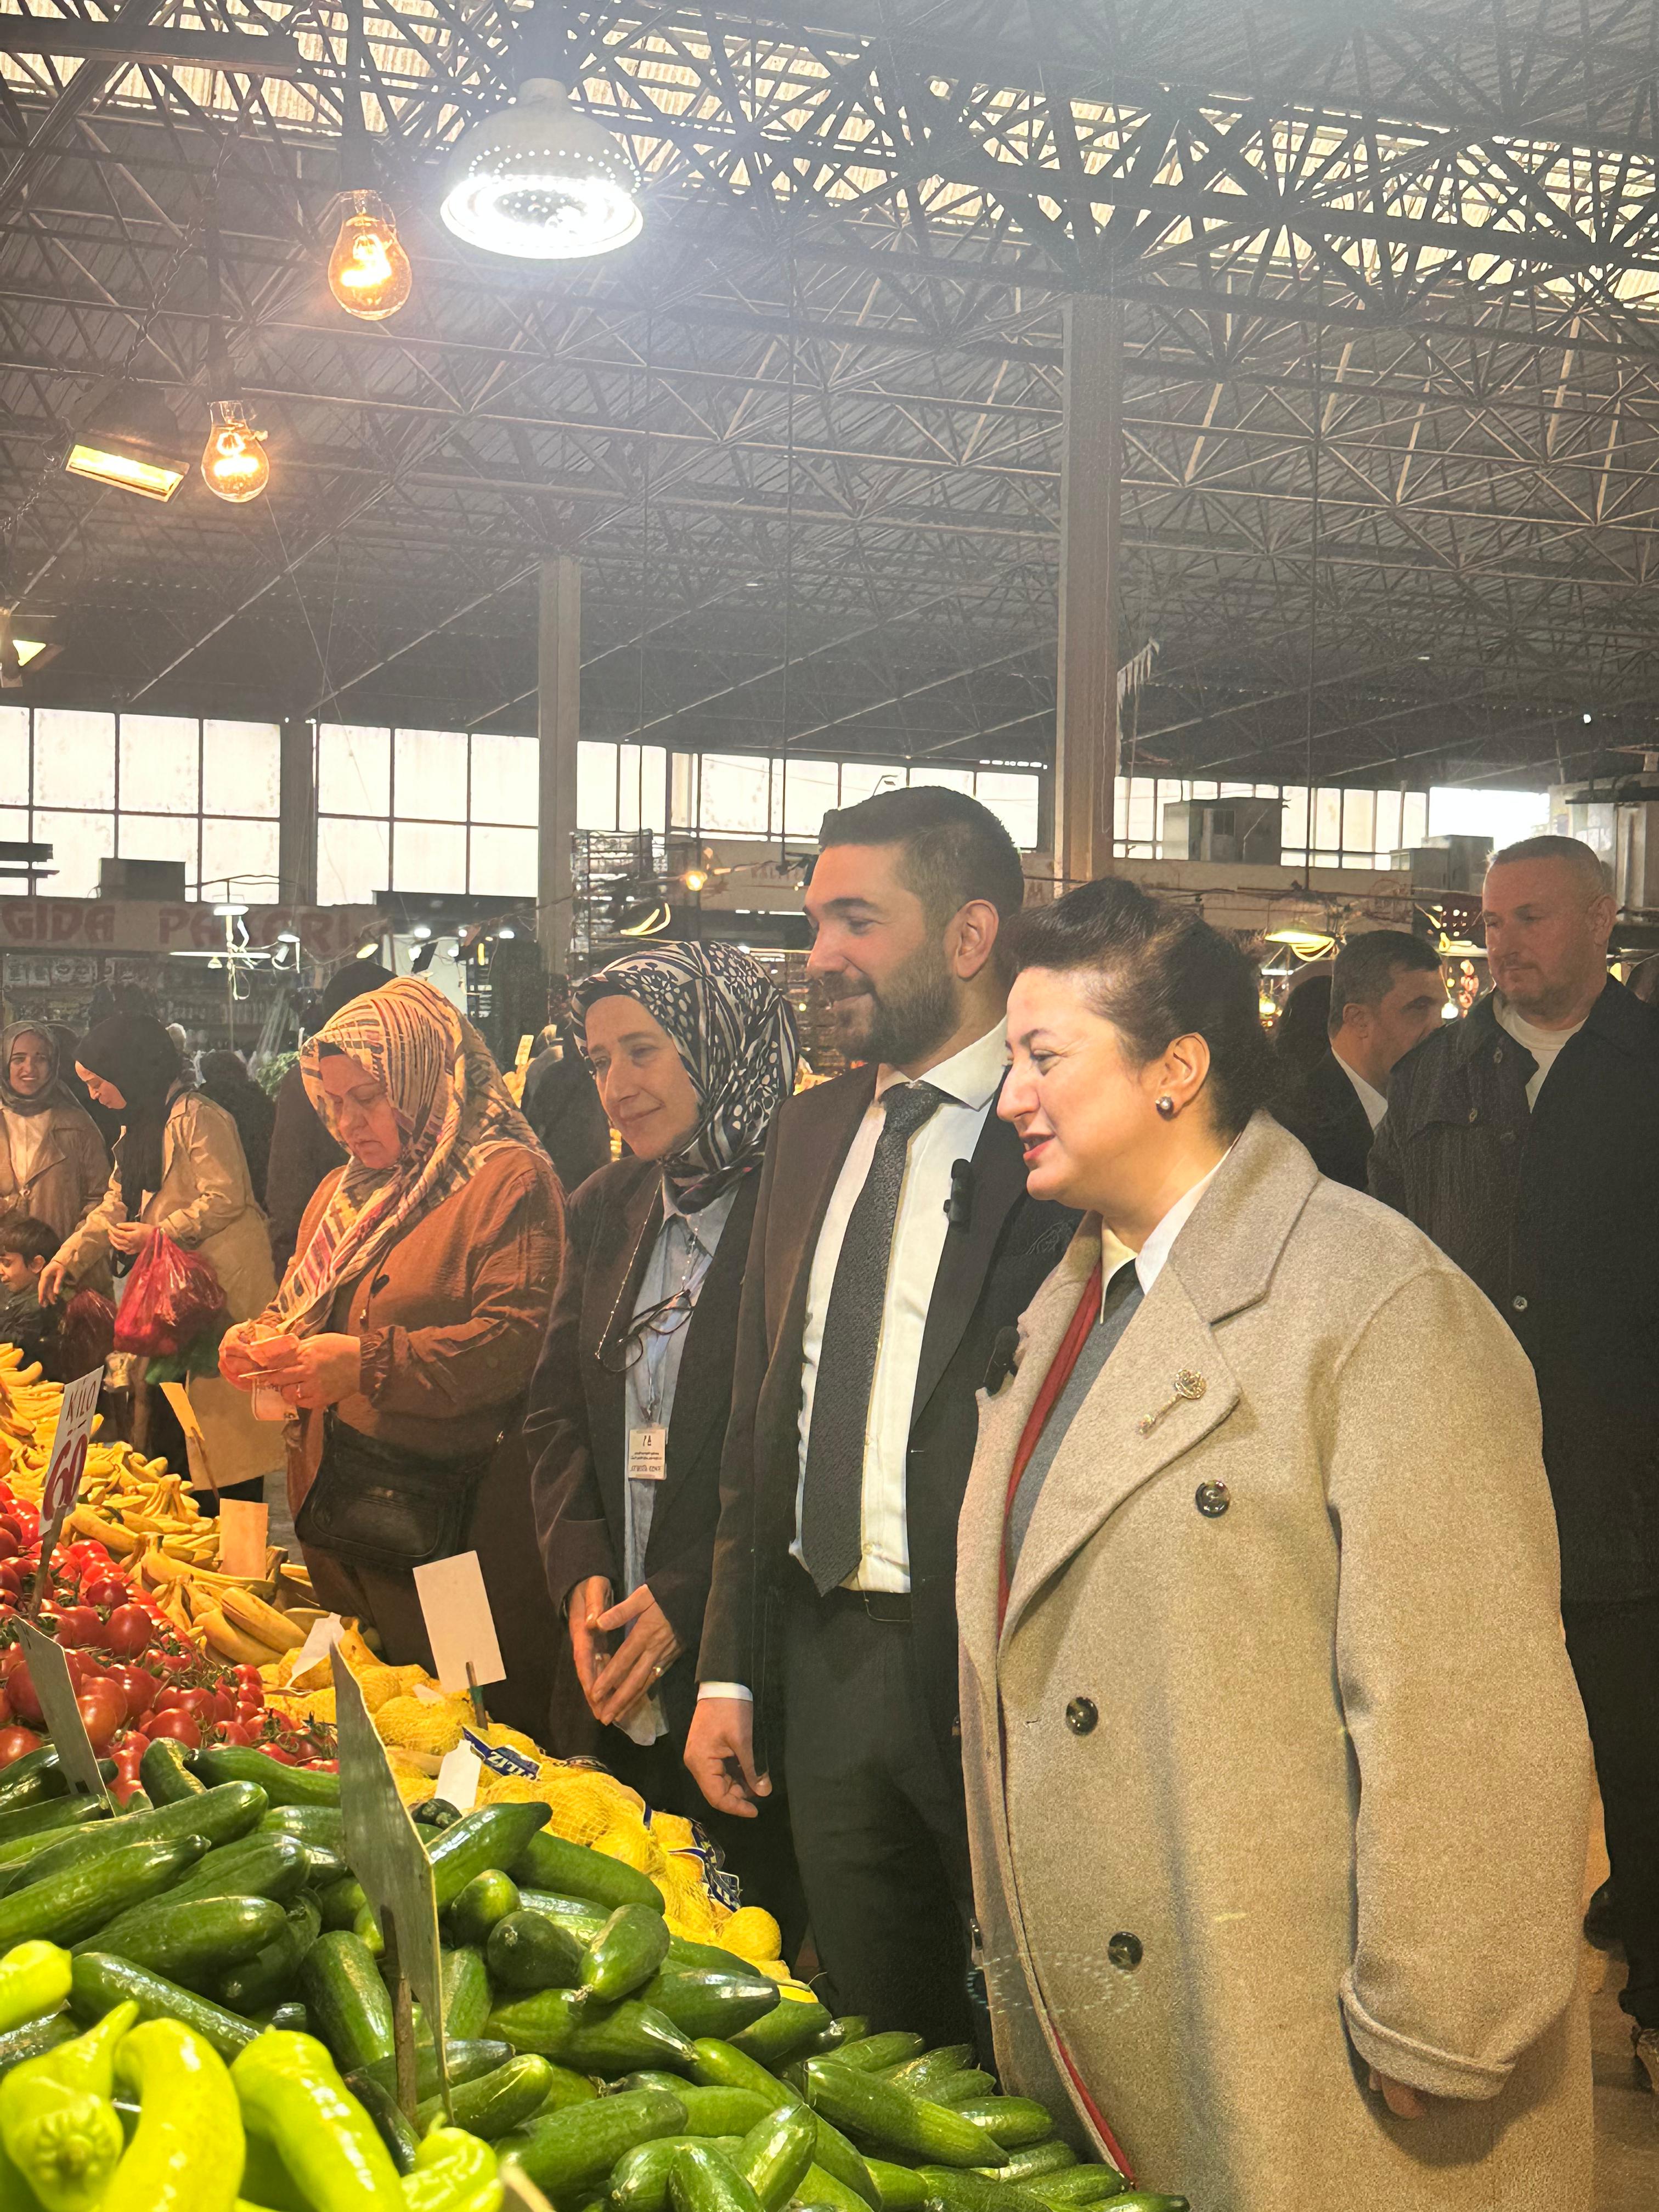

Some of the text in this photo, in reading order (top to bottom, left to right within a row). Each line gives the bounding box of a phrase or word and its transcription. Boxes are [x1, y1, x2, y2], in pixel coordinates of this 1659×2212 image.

[2, 901, 350, 954] GIDA PAARI
[43, 1433, 87, 1521] 60
